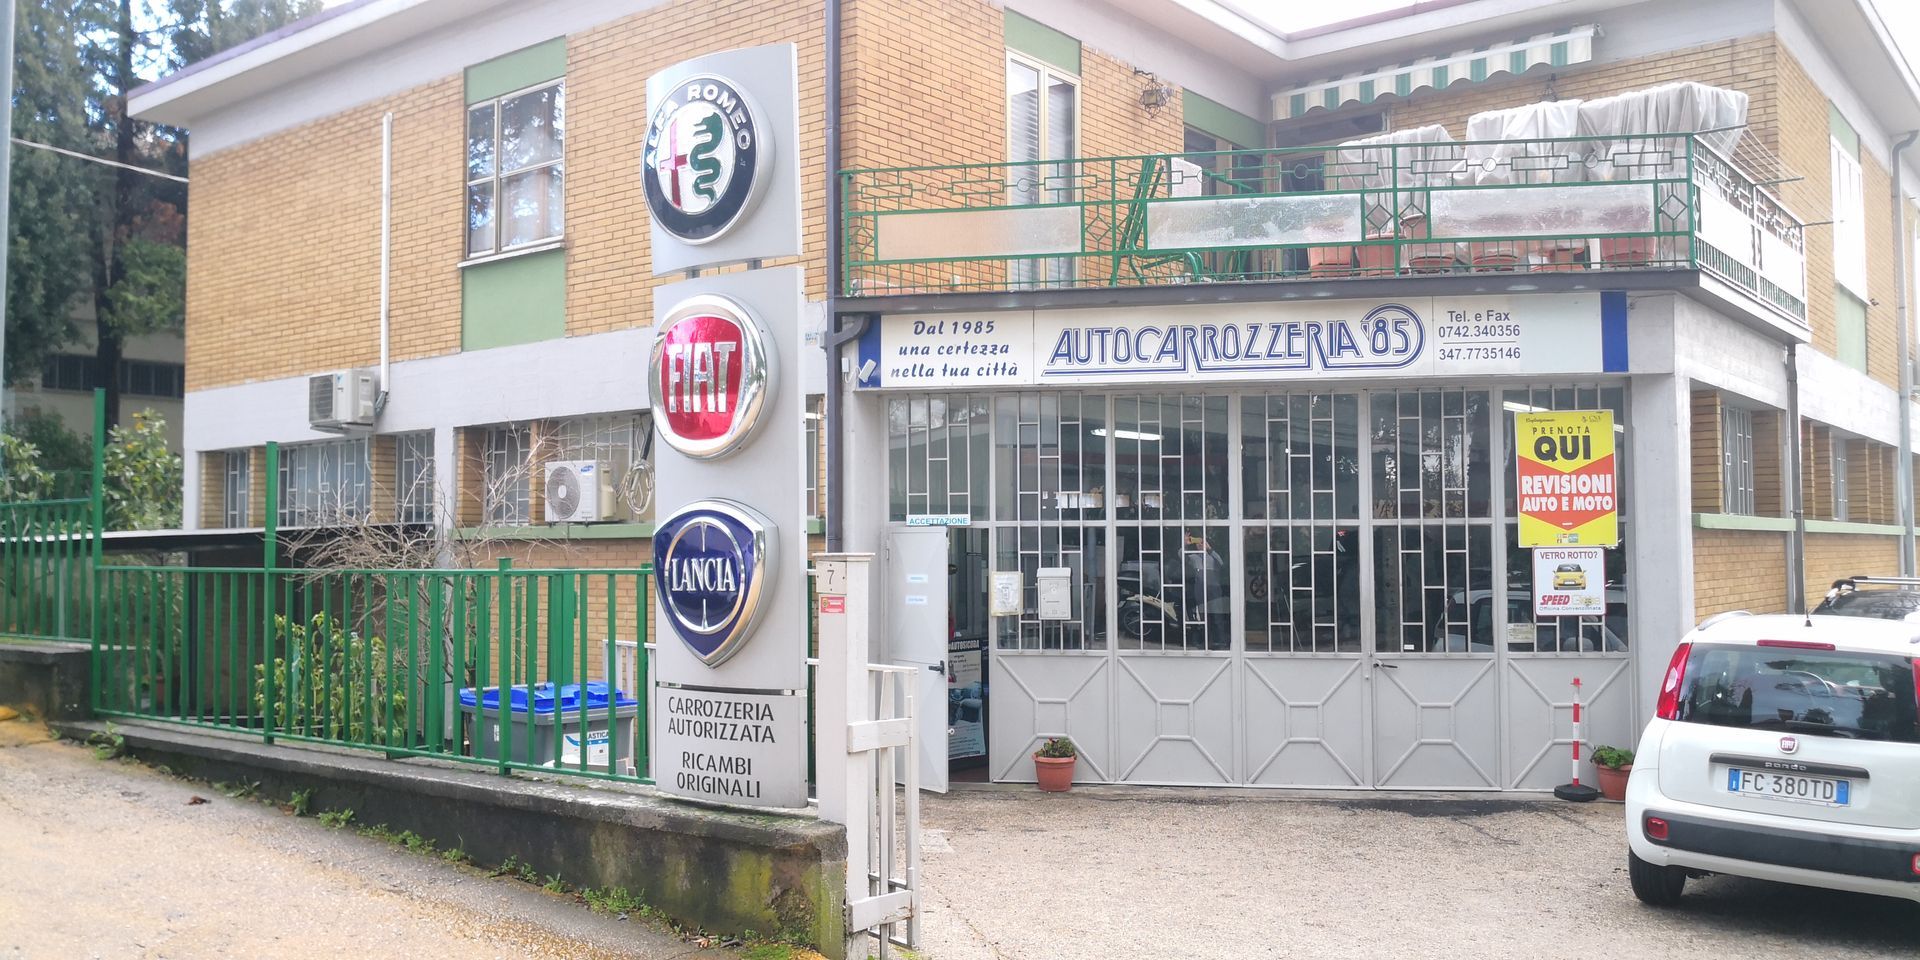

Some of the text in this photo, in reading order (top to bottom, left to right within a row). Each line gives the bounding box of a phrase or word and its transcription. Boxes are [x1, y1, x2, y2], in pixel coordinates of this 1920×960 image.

[646, 85, 750, 170] ALFA ROMEO
[1447, 310, 1510, 322] Tel. e Fax
[914, 320, 995, 335] Dal 1985
[1439, 325, 1520, 337] 0742.340356
[899, 341, 1009, 355] una certezza
[1045, 320, 1363, 373] AUTOCARROZZERIA
[1440, 348, 1520, 360] 347.7735146
[667, 341, 736, 412] FIAT
[891, 363, 1018, 378] nella tua città
[1533, 426, 1590, 434] PRENOTA
[1534, 436, 1591, 462] QUI
[1522, 474, 1612, 494] REVISIONI
[1522, 496, 1612, 511] AUTO E MOTO
[1568, 551, 1597, 559] ROTTO?
[672, 558, 735, 592] LANCIA
[827, 570, 834, 584] 7
[1541, 595, 1570, 605] SPEED
[669, 697, 774, 721] CARROZZERIA
[668, 718, 775, 743] AUTORIZZATA
[682, 752, 751, 775] RICAMBI
[677, 772, 760, 798] ORIGINALI
[1742, 773, 1765, 791] FC
[1773, 776, 1833, 799] 380TD
